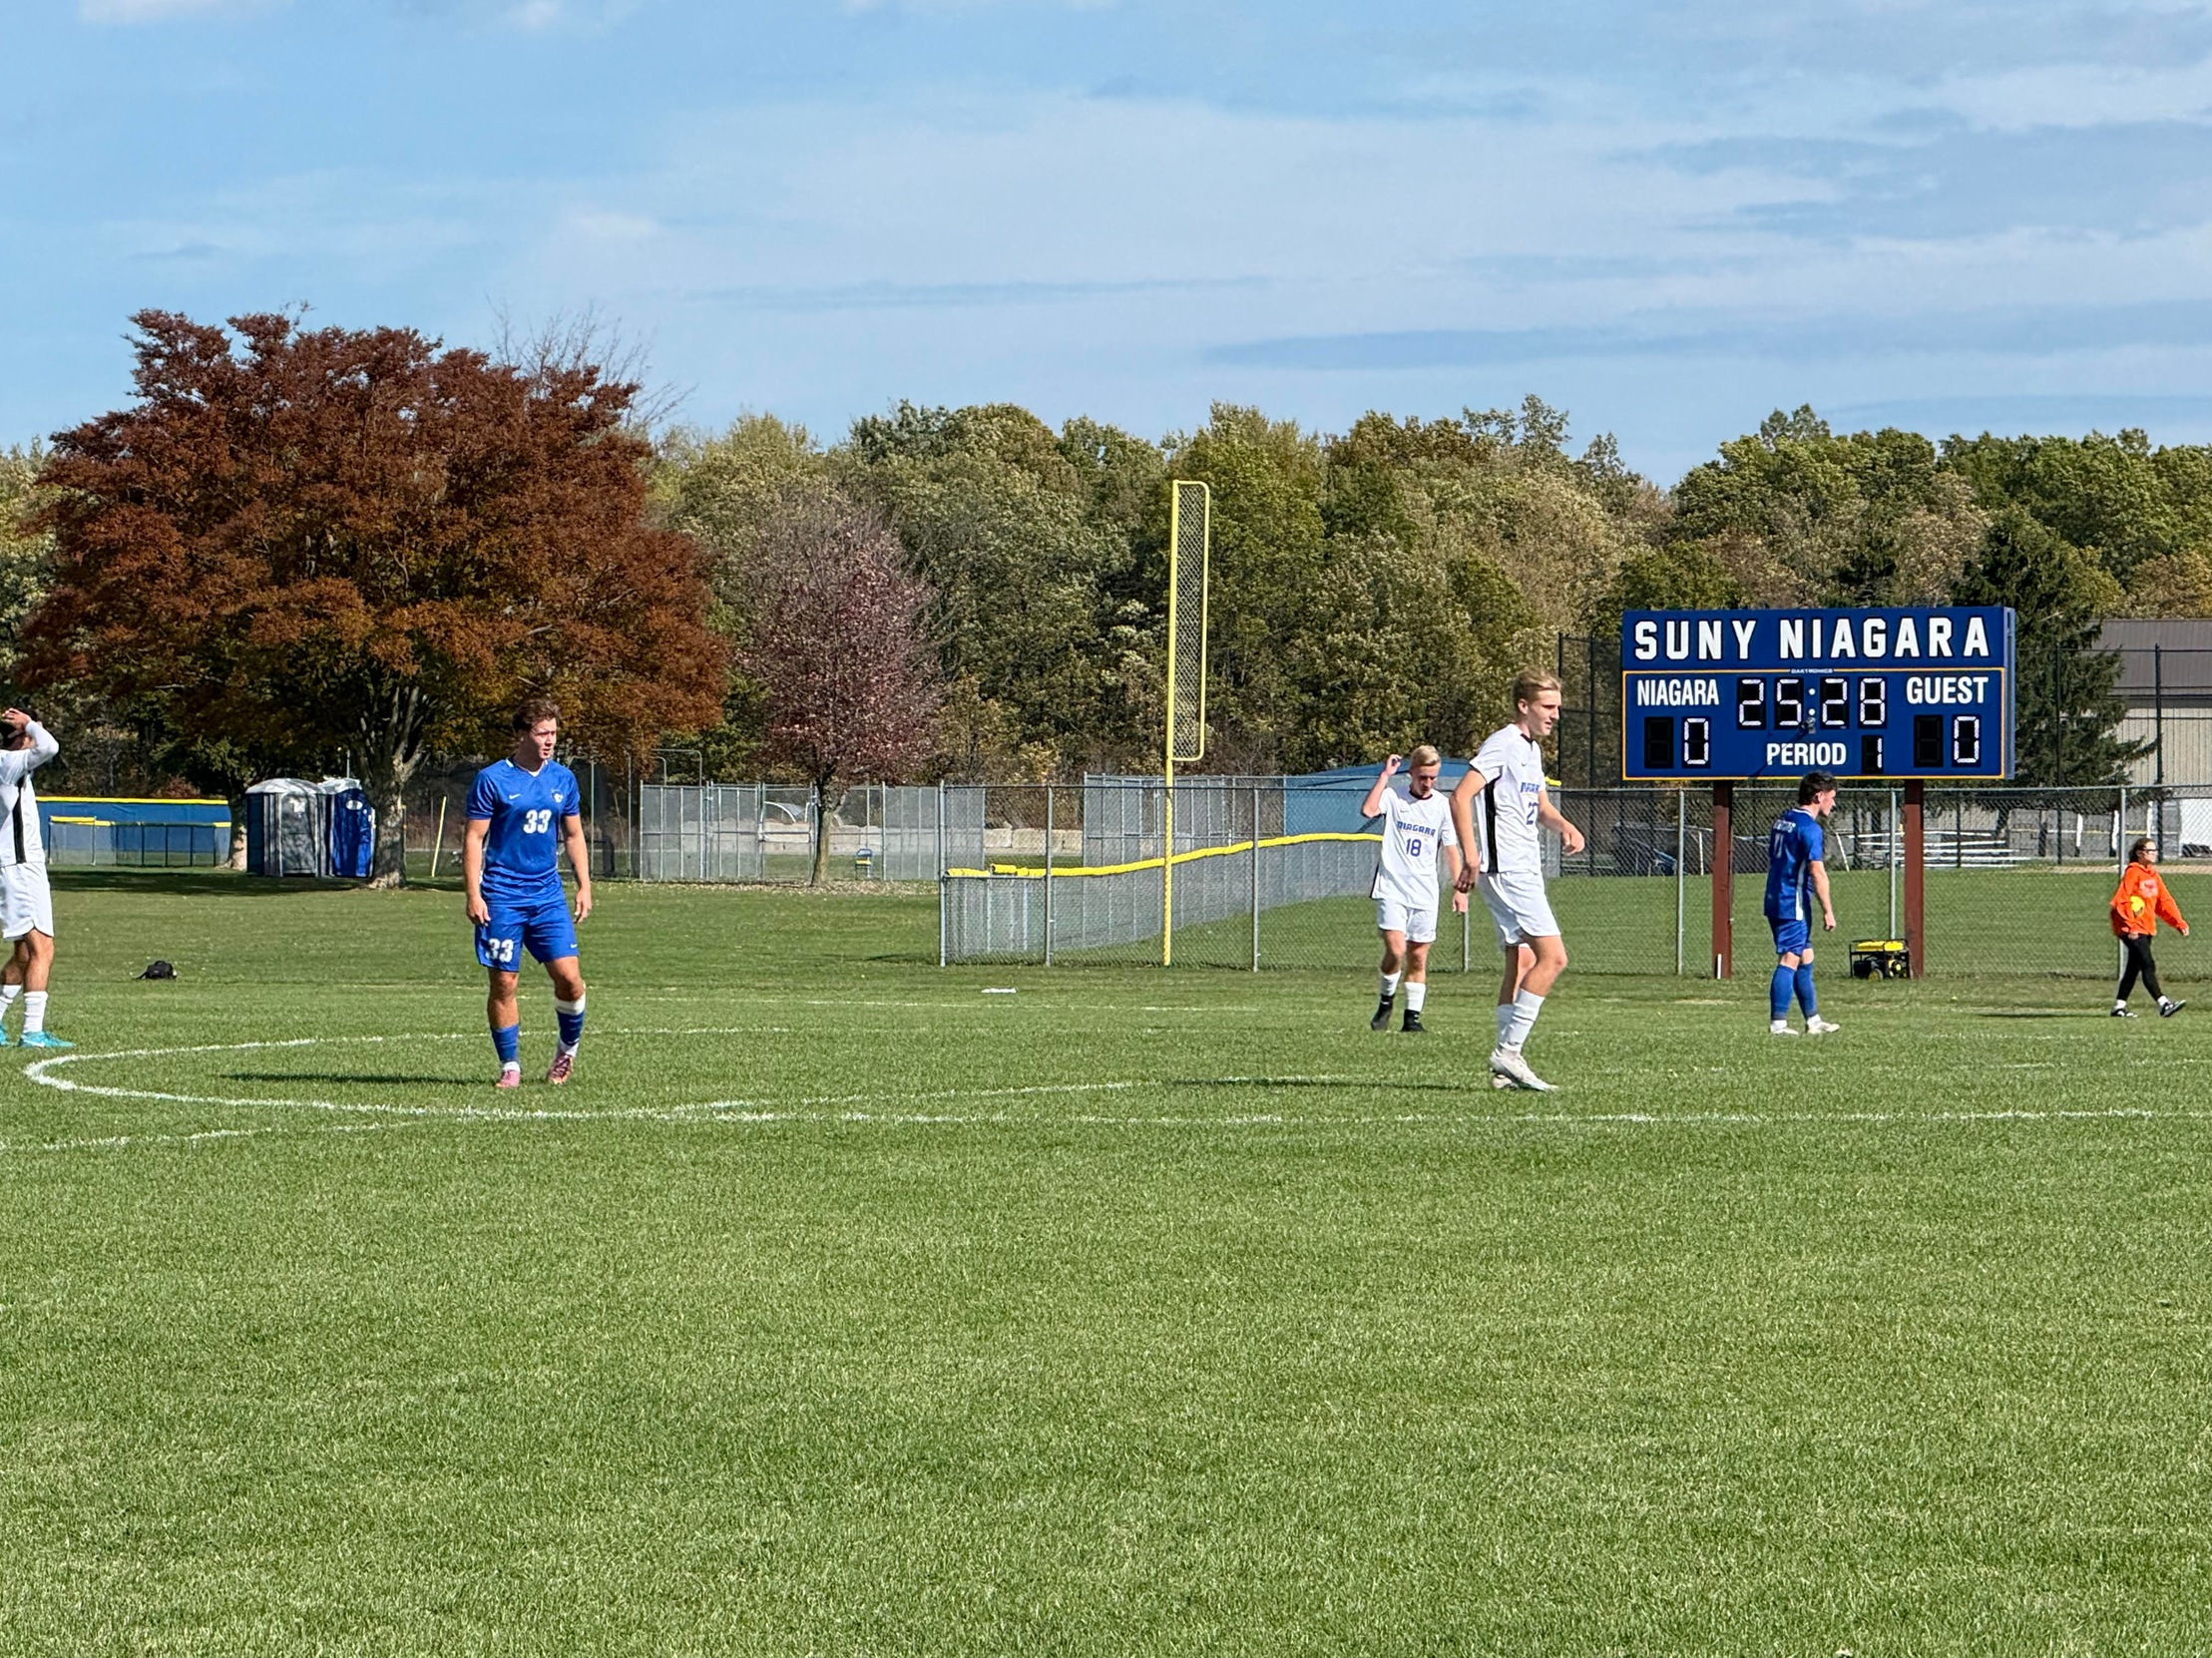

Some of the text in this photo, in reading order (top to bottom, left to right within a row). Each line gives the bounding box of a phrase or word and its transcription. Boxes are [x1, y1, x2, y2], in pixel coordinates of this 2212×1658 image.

[1634, 617, 1990, 660] SUNY NIAGARA
[1636, 678, 1720, 706] NIAGARA
[1738, 677, 1886, 726] 25:28
[1906, 676, 1990, 704] GUEST
[1683, 717, 1709, 765] 0
[1876, 737, 1884, 769] 1
[1953, 715, 1980, 764] 0
[1766, 742, 1847, 766] PERIOD
[522, 808, 553, 834] 33
[1396, 820, 1437, 837] NIAGARA
[1405, 837, 1422, 858] 18
[485, 938, 514, 963] 33
